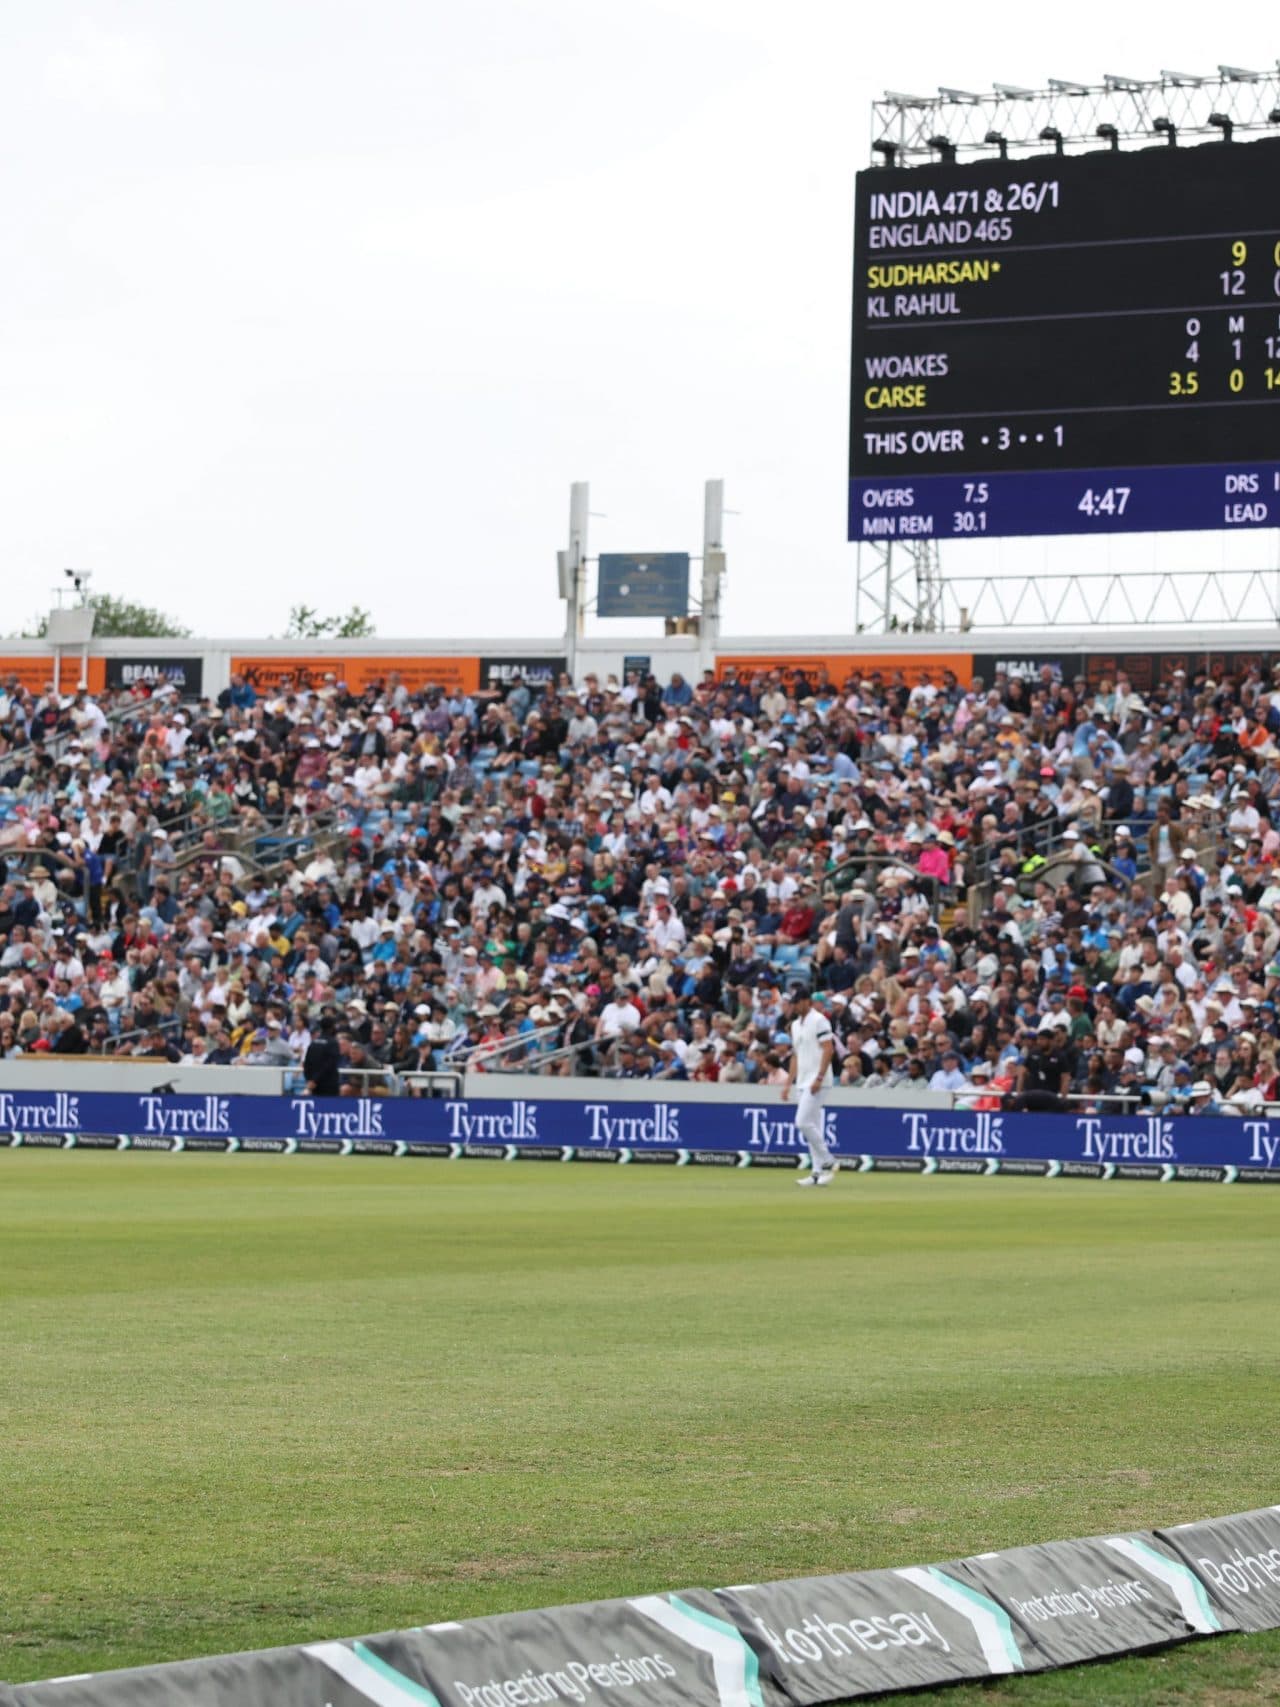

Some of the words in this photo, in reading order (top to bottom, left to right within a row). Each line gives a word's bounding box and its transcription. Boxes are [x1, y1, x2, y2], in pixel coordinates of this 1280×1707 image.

[870, 190, 941, 220] INDIA
[943, 191, 978, 214] 471
[984, 189, 1004, 212] &
[1007, 181, 1059, 213] 26/1
[869, 221, 972, 249] ENGLAND
[974, 217, 1012, 241] 465
[1232, 241, 1247, 266] 9
[867, 297, 889, 318] KL
[894, 292, 960, 316] RAHUL
[1220, 270, 1245, 295] 12
[1186, 318, 1200, 336] O
[1229, 316, 1244, 333] M
[865, 354, 949, 379] WOAKES
[1186, 341, 1199, 363] 4
[1232, 338, 1241, 360] 1
[864, 385, 927, 410] CARSE
[1169, 372, 1198, 395] 3.5
[1230, 369, 1243, 392] 0
[864, 432, 907, 455] THIS
[912, 430, 964, 454] OVER
[998, 427, 1010, 450] 3
[1054, 425, 1063, 447] 1
[862, 488, 914, 508] OVERS
[964, 482, 989, 503] 7.5
[1225, 474, 1259, 493] DRS
[1078, 486, 1131, 516] 4:47
[1224, 503, 1267, 523] LEAD
[863, 517, 896, 535] MIN
[900, 515, 933, 534] REM
[953, 512, 987, 532] 30.1
[567, 1650, 677, 1692] Pensions
